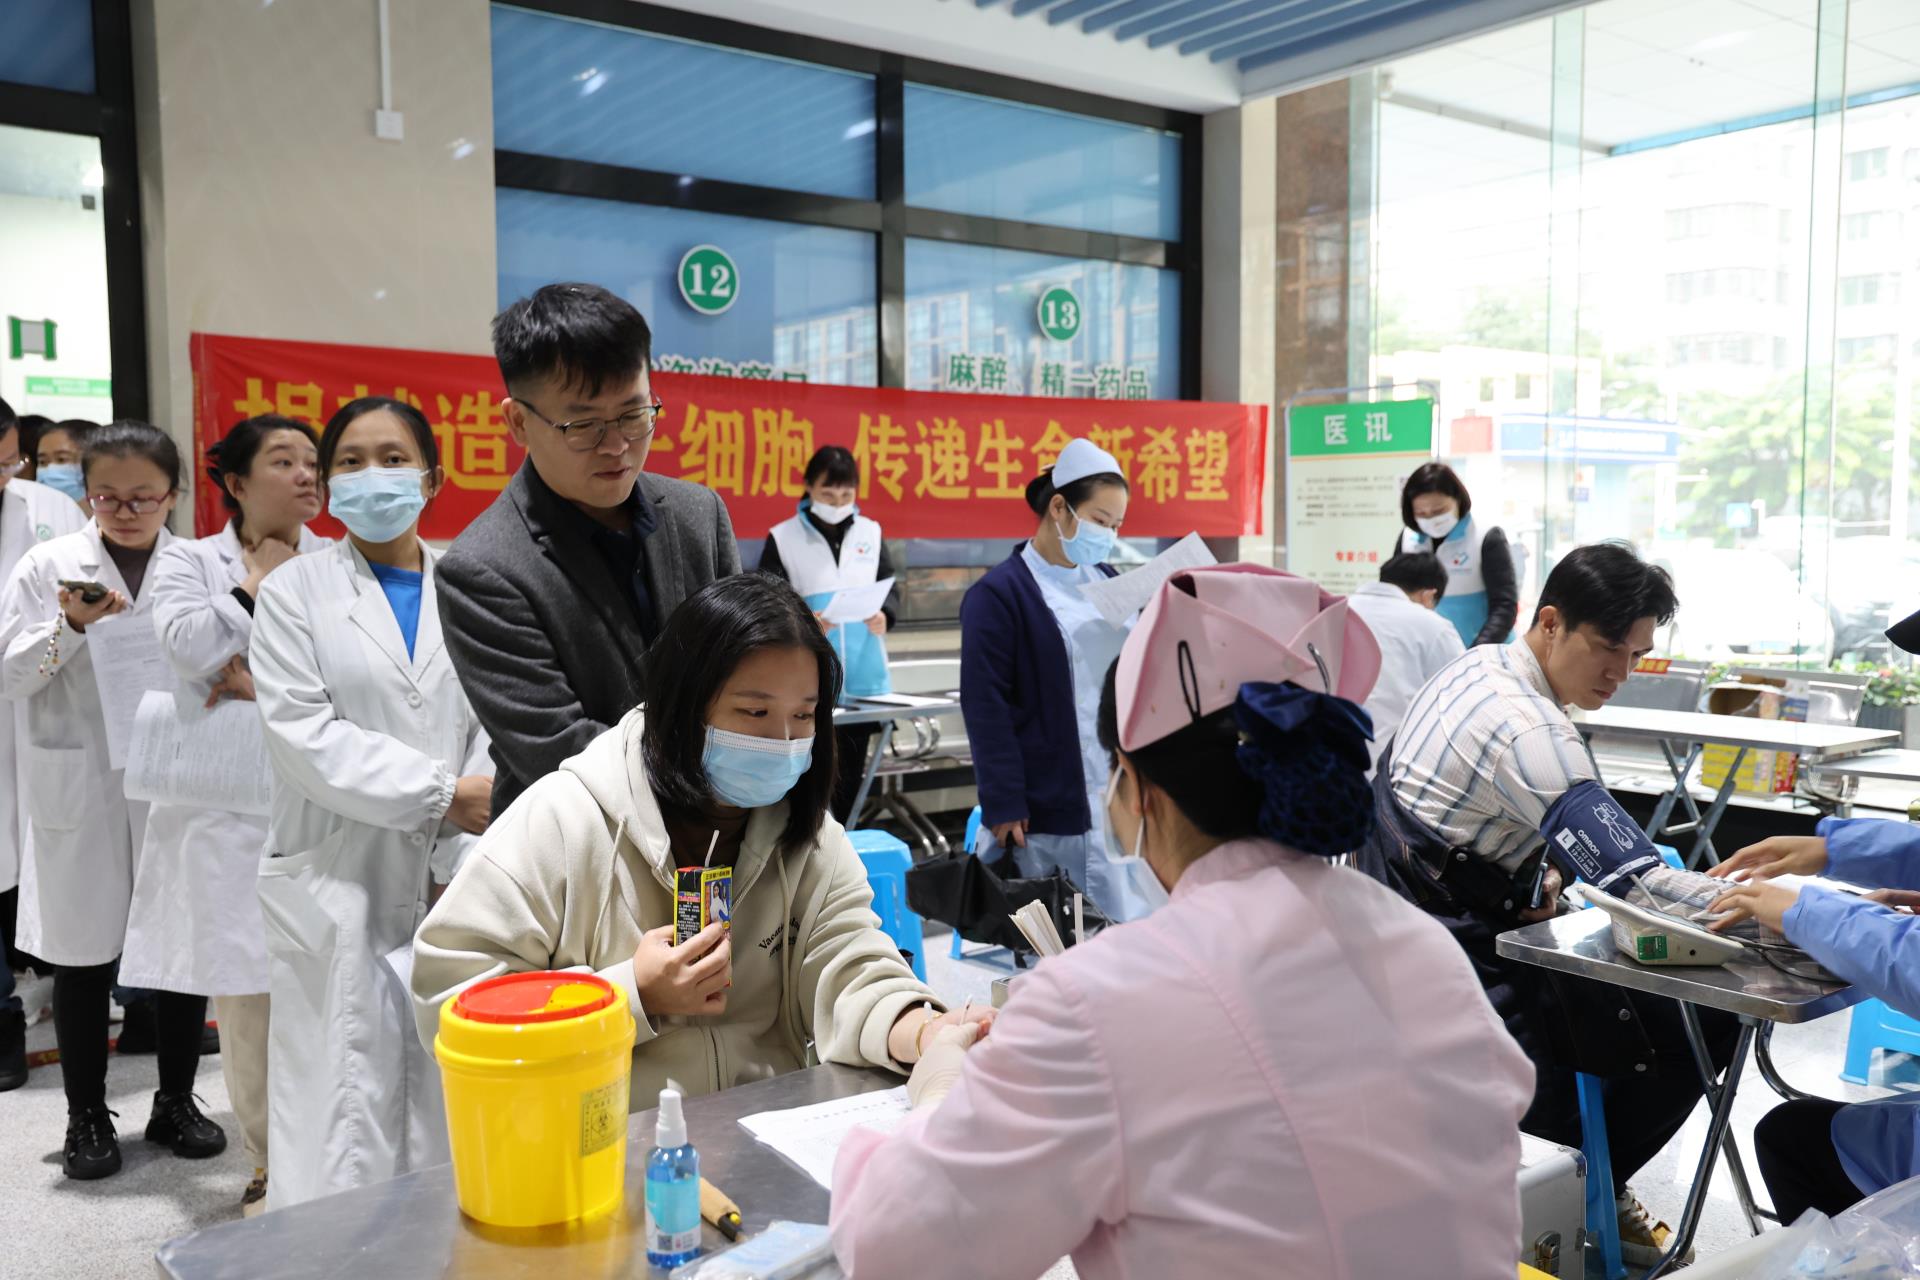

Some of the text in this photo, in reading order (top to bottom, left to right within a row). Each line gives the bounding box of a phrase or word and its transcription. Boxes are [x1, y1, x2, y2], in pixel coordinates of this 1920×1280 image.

[689, 262, 731, 297] 12
[1045, 300, 1077, 330] 13
[1324, 412, 1393, 446] 医讯
[1562, 833, 1569, 843] L
